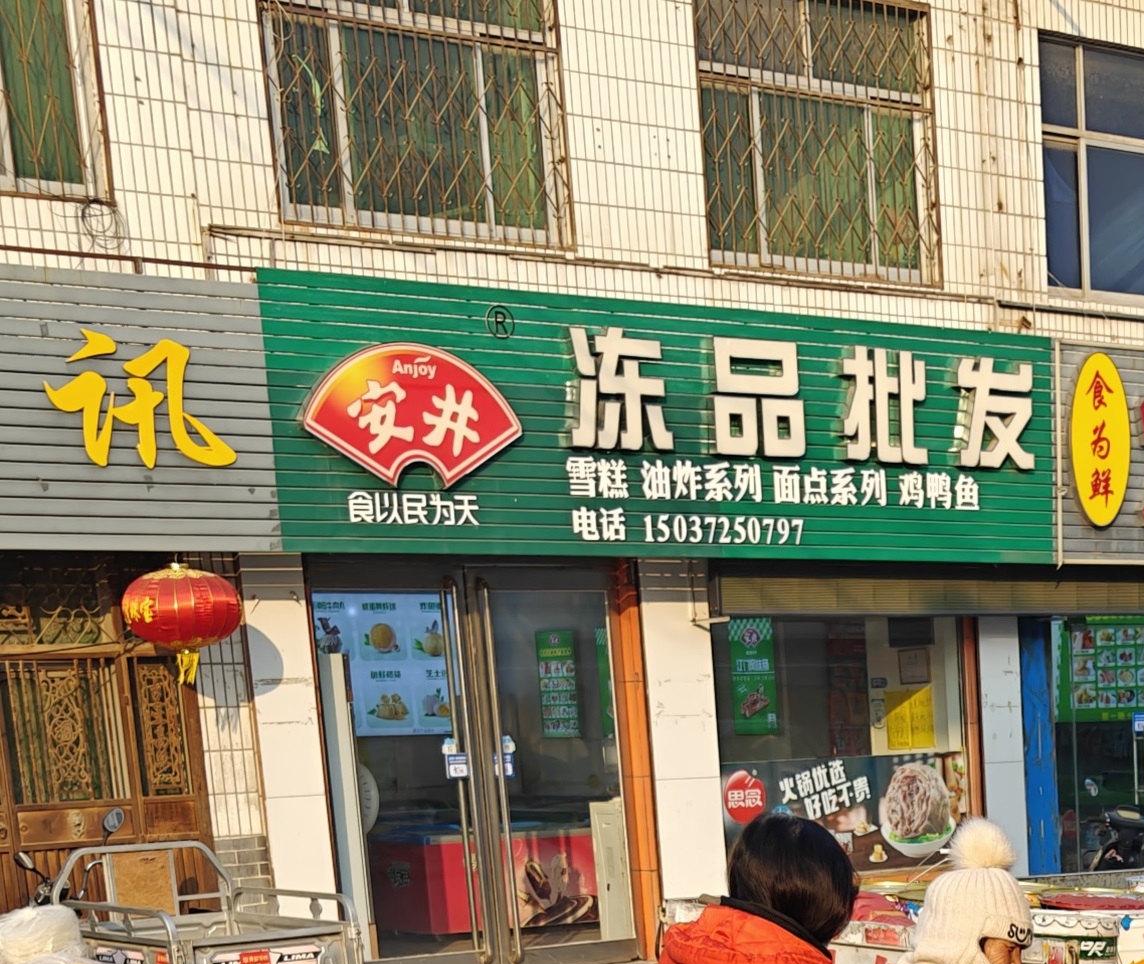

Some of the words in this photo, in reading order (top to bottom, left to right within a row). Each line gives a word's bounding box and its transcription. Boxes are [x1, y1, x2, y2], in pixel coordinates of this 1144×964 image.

[392, 356, 438, 380] Anjoy
[43, 329, 237, 469] 讯
[347, 379, 481, 457] 安井
[568, 326, 1036, 470] 冻品批发
[1086, 369, 1115, 508] 食为鲜
[565, 456, 629, 500] 雪糕
[641, 459, 763, 503] 油炸系列
[772, 465, 888, 507] 面点系列
[898, 472, 981, 511] 鸡鸭鱼
[347, 491, 480, 526] 食以民为天
[571, 506, 627, 542] 电话
[643, 513, 805, 545] 15037250797
[727, 787, 764, 809] 思念
[778, 759, 848, 804] 火锅优选
[283, 952, 315, 961] LIMA
